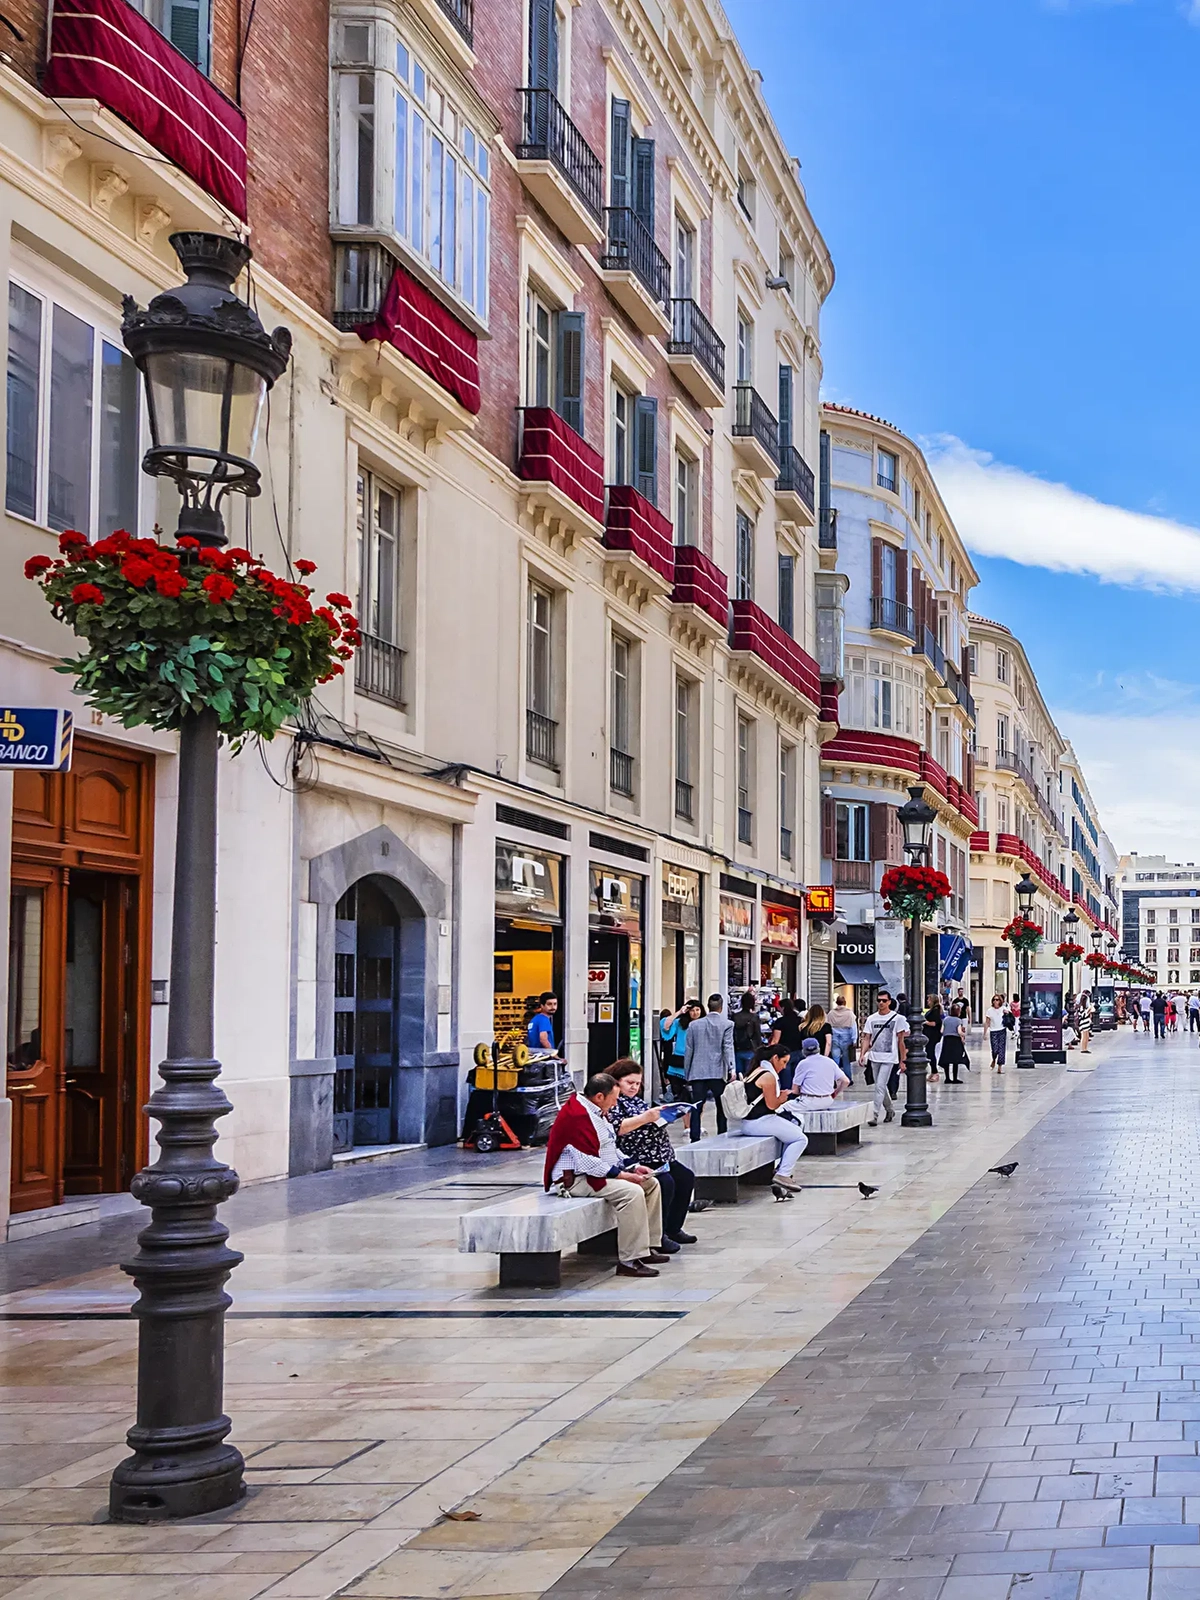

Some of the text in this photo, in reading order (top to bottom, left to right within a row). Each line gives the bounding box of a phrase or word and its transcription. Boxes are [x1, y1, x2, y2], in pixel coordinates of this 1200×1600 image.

[91, 710, 103, 726] 12
[838, 944, 875, 954] TOUS
[951, 946, 966, 968] SUR
